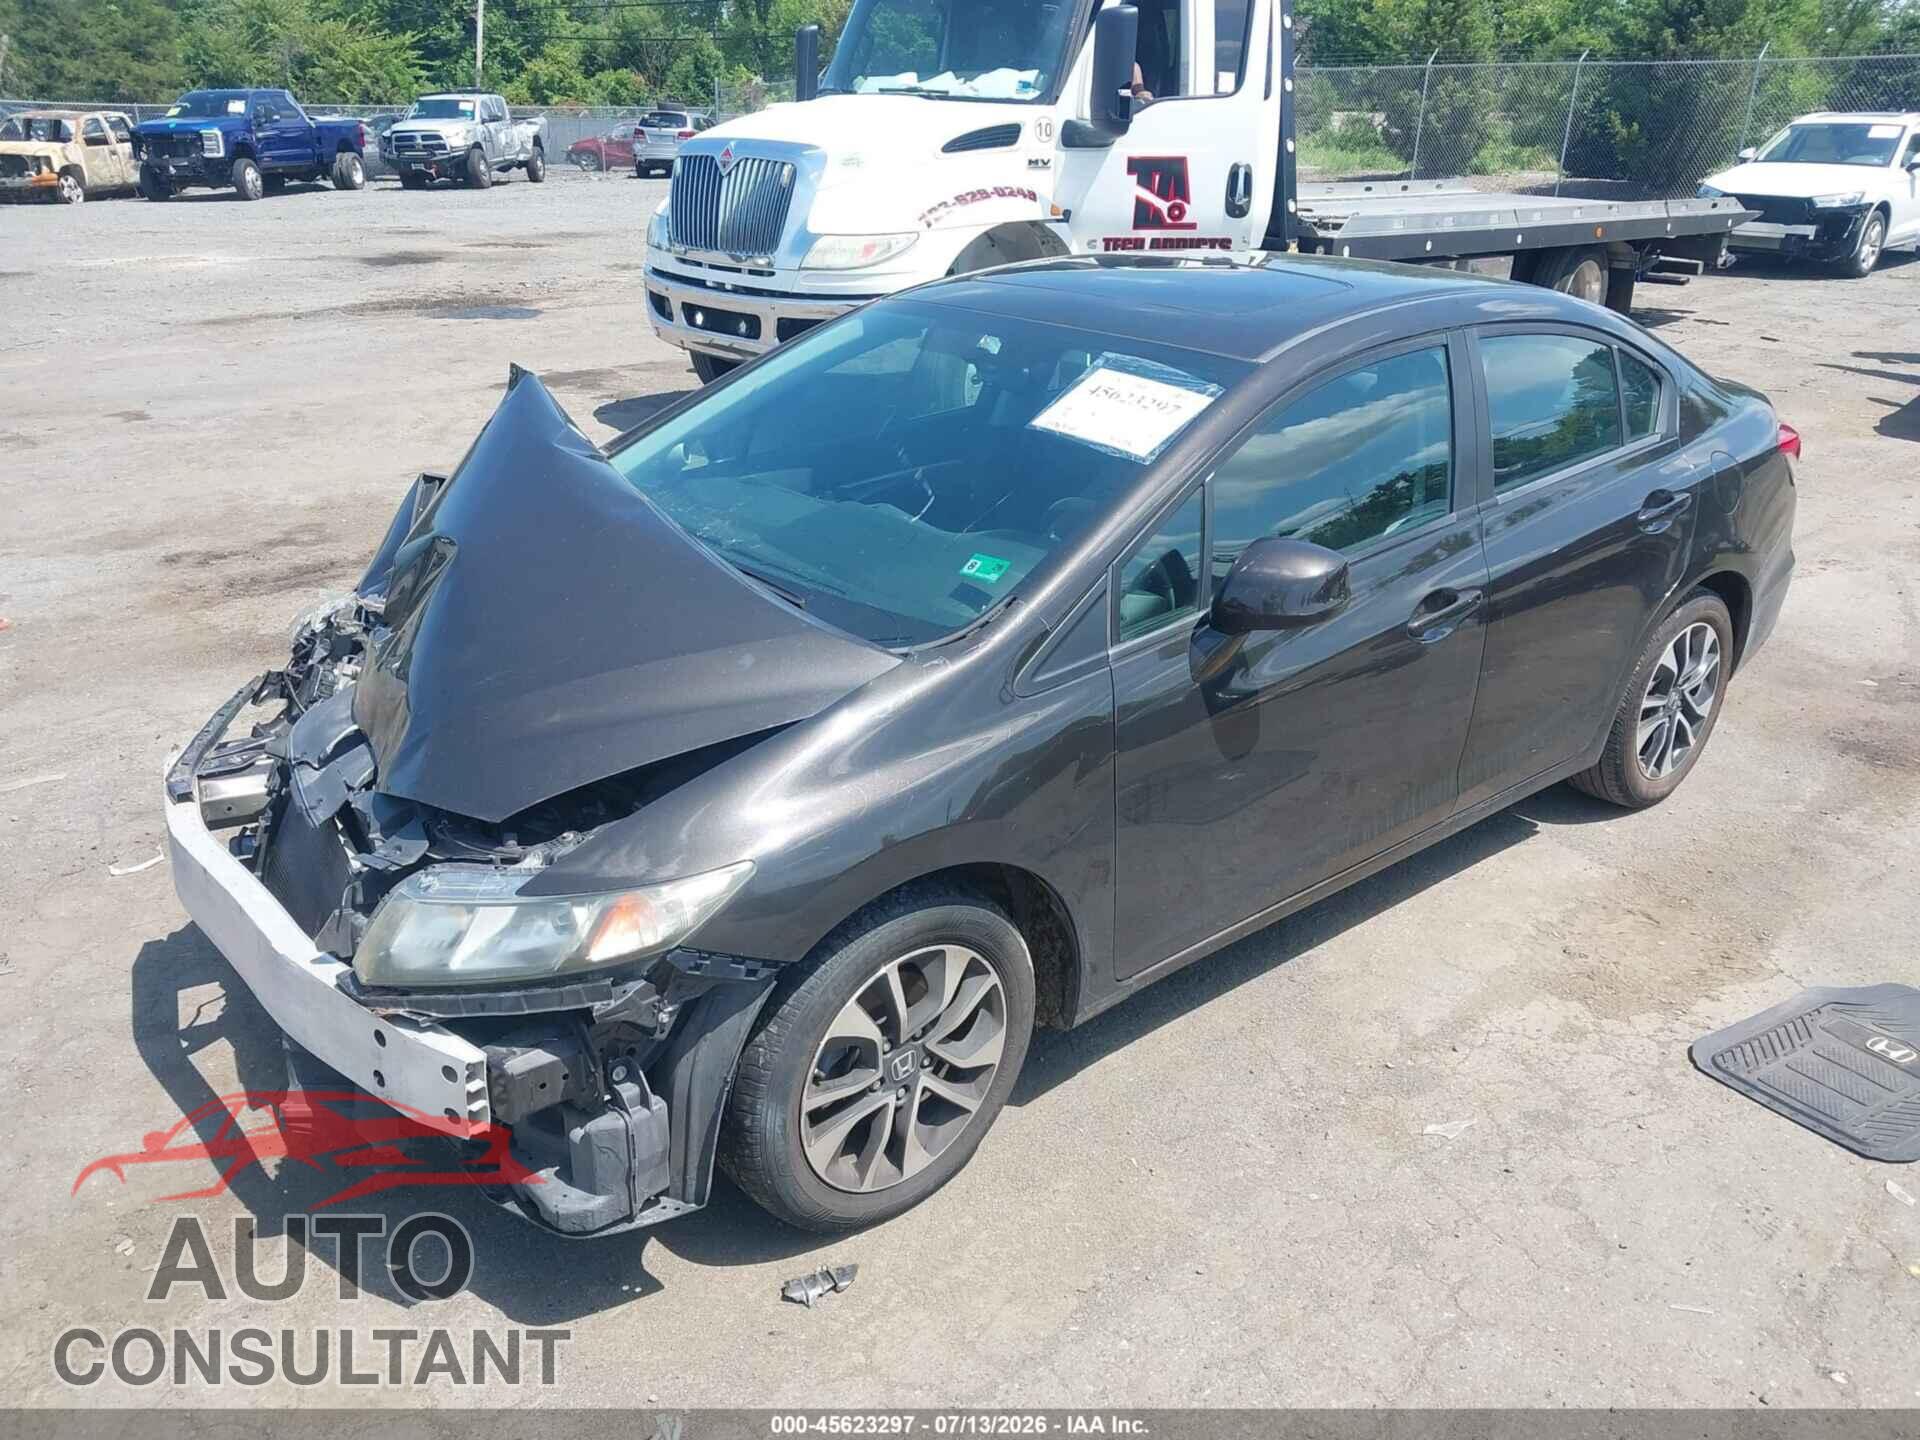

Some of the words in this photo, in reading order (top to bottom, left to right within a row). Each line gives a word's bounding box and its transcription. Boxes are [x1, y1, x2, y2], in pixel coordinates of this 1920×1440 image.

[1037, 122, 1052, 137] 10
[1028, 158, 1051, 166] MV
[1102, 237, 1146, 252] TECH
[1149, 237, 1233, 251] ADDICTS
